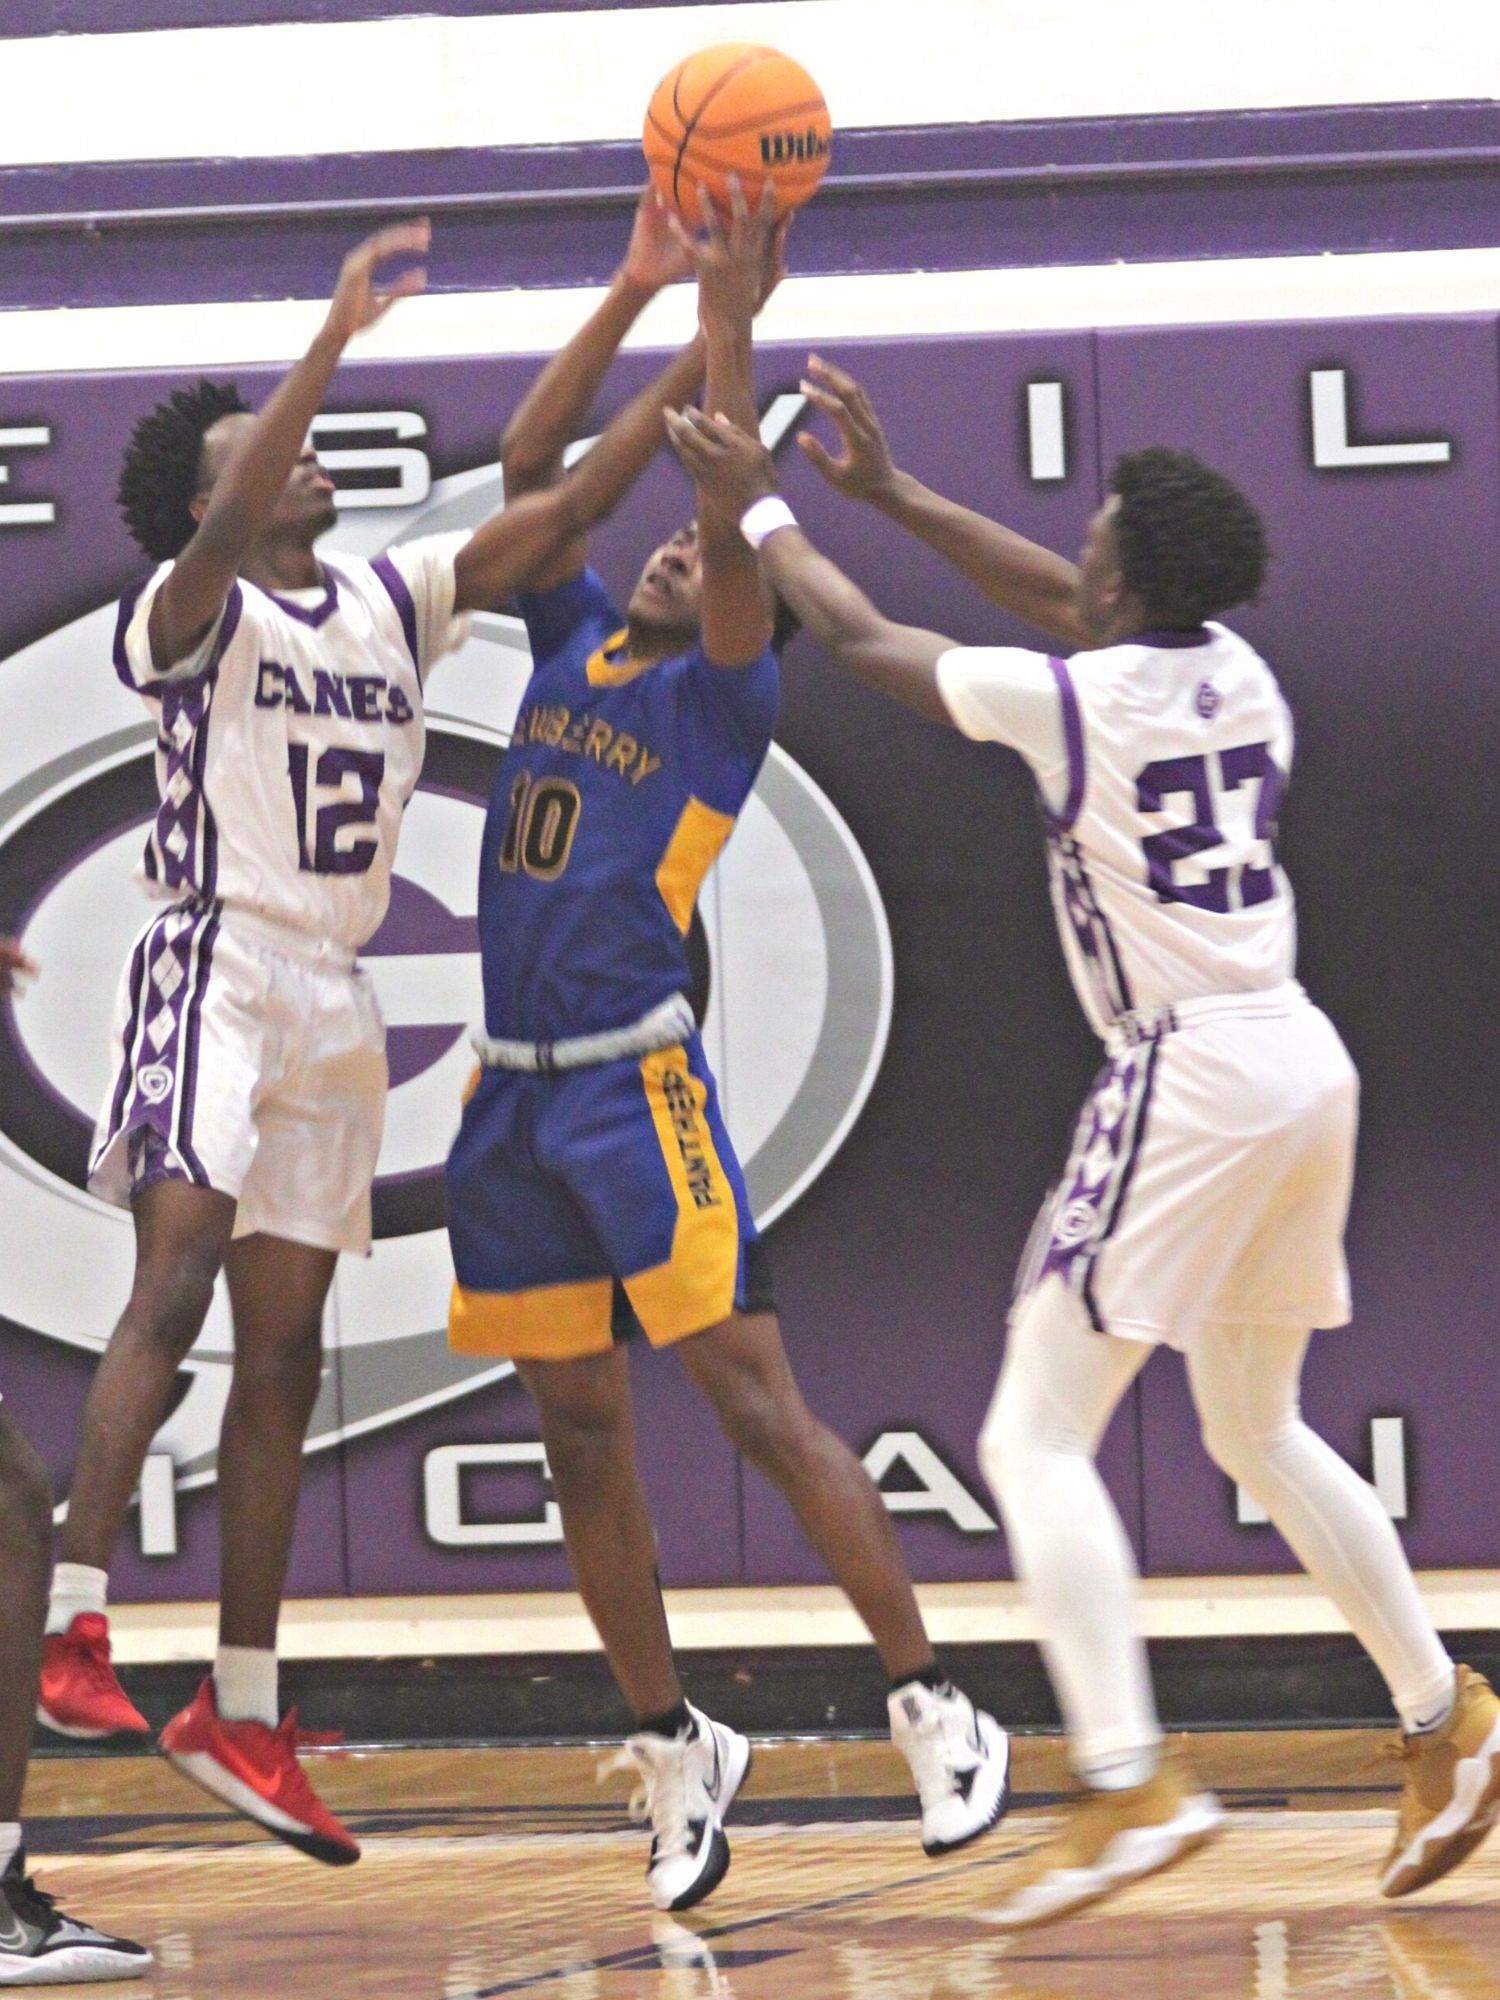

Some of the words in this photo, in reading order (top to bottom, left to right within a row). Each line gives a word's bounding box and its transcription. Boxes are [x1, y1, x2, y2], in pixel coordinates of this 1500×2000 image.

[255, 660, 413, 725] CANES
[287, 743, 385, 876] 12
[500, 767, 581, 882] 10
